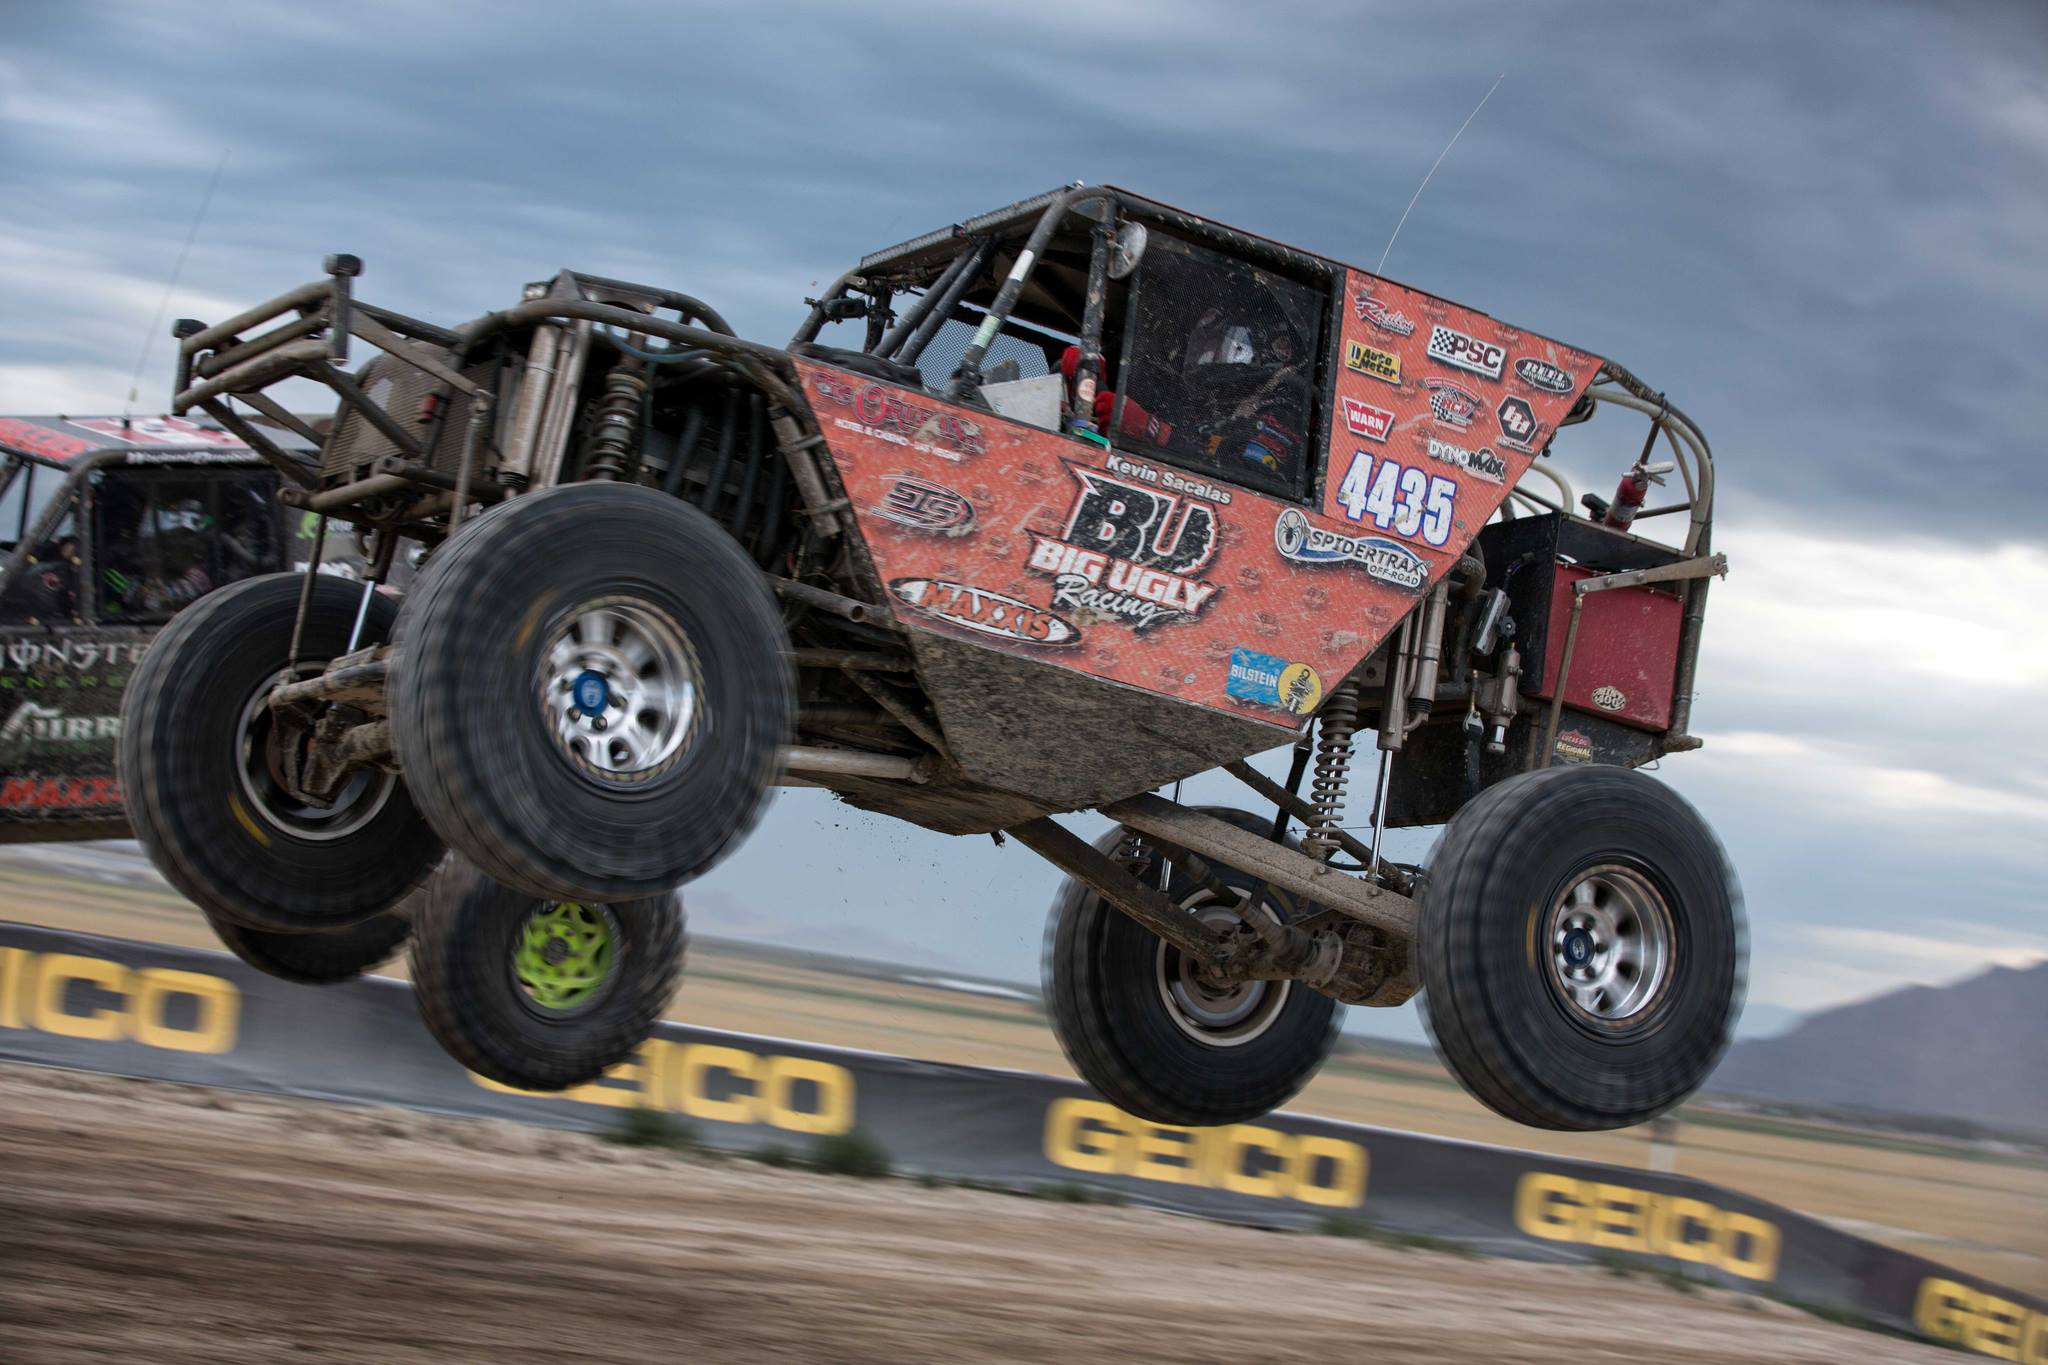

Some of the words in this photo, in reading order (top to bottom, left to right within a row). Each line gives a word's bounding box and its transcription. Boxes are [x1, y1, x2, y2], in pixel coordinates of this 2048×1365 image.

[1359, 358, 1397, 378] Meter
[1362, 348, 1393, 366] Auto
[1450, 335, 1501, 369] PSC
[1349, 408, 1384, 433] WARN
[1106, 454, 1158, 483] Kevin
[1161, 471, 1232, 505] Sacalas
[1427, 439, 1505, 481] DYNOMAX
[1059, 466, 1217, 576] BU
[1338, 450, 1457, 546] 4435
[1029, 538, 1108, 584] BIG
[1107, 559, 1217, 613] UGLY
[1311, 531, 1422, 577] SPIDERTRAX
[1369, 564, 1419, 586] OFF-ROAD
[919, 582, 1052, 640] MAXXIS
[1052, 574, 1180, 628] Racing
[1231, 664, 1278, 688] BILSTEIN
[1556, 741, 1592, 757] REGIONAL
[0, 944, 241, 1054] ICO
[1042, 1096, 1371, 1209] GEICO
[1513, 1170, 1783, 1282] GEICO
